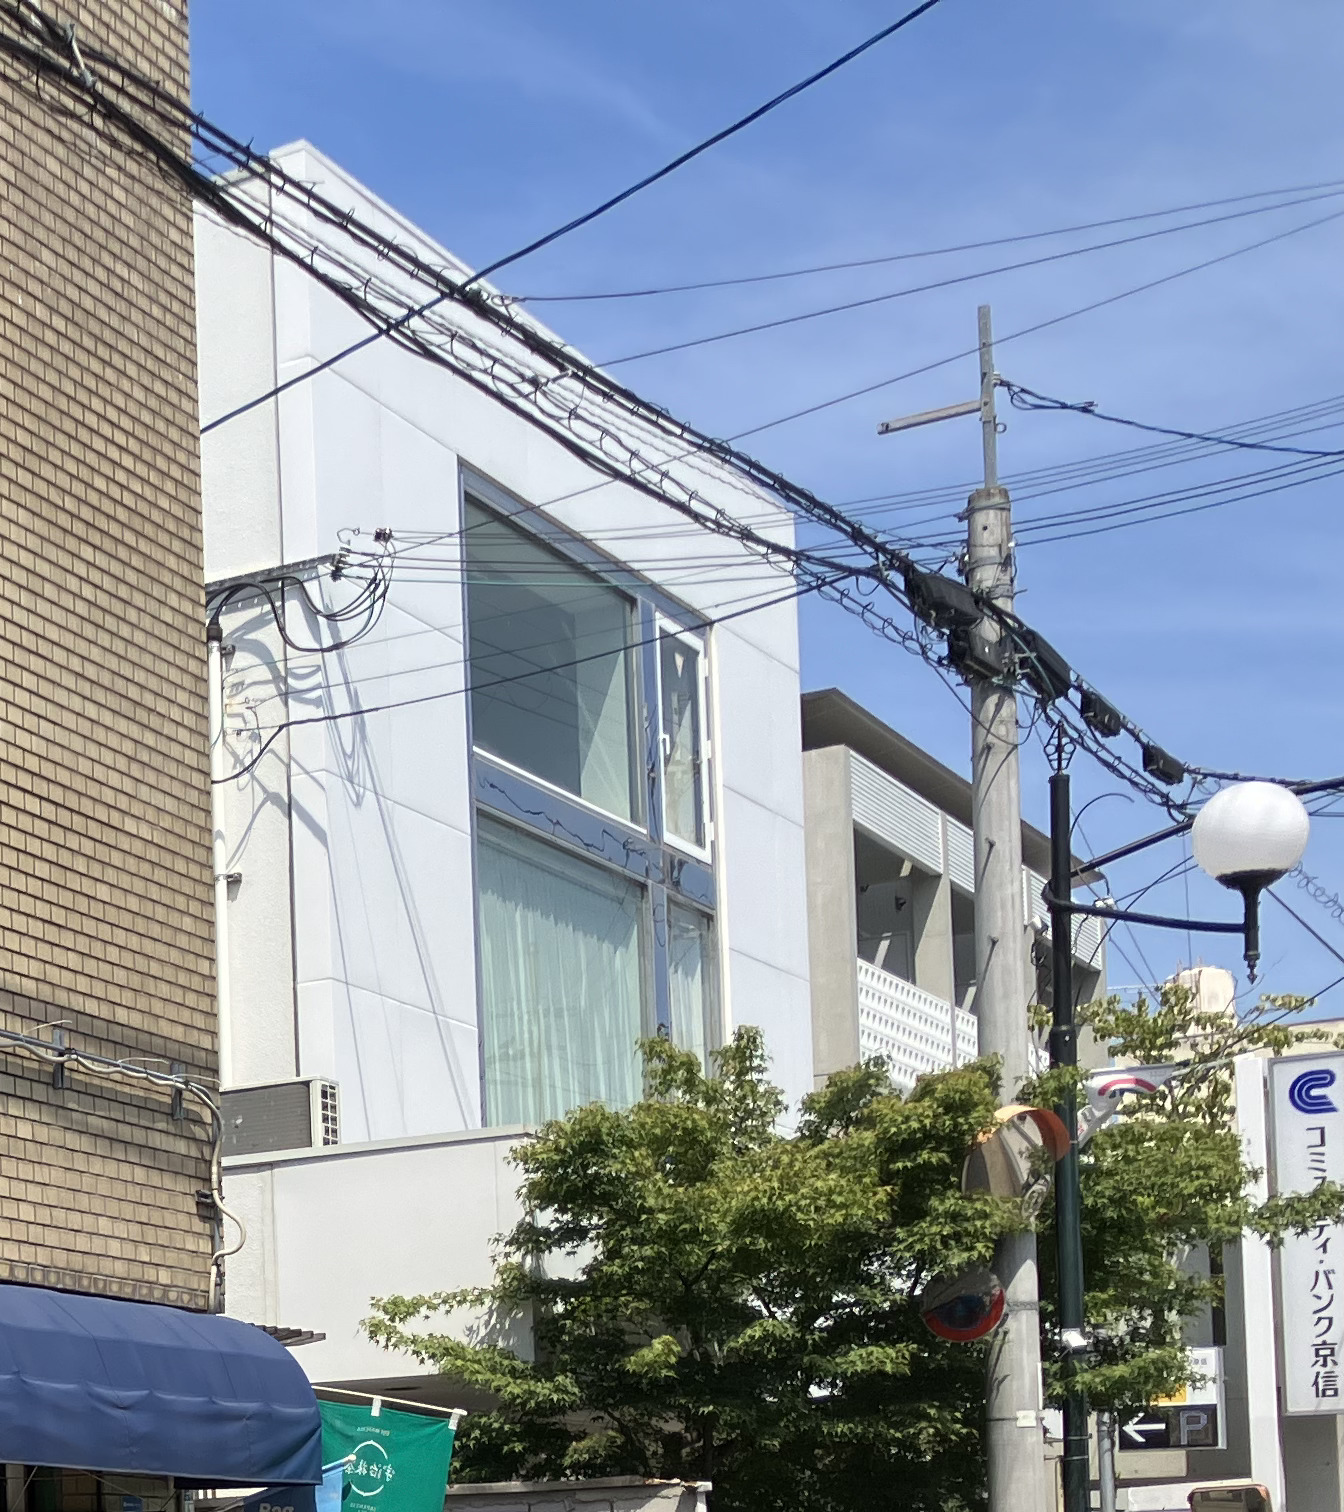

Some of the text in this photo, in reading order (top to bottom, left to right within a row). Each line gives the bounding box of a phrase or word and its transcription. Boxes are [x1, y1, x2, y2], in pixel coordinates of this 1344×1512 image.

[1305, 1125, 1340, 1399] コミティ・バンク京信
[1179, 1409, 1209, 1446] P
